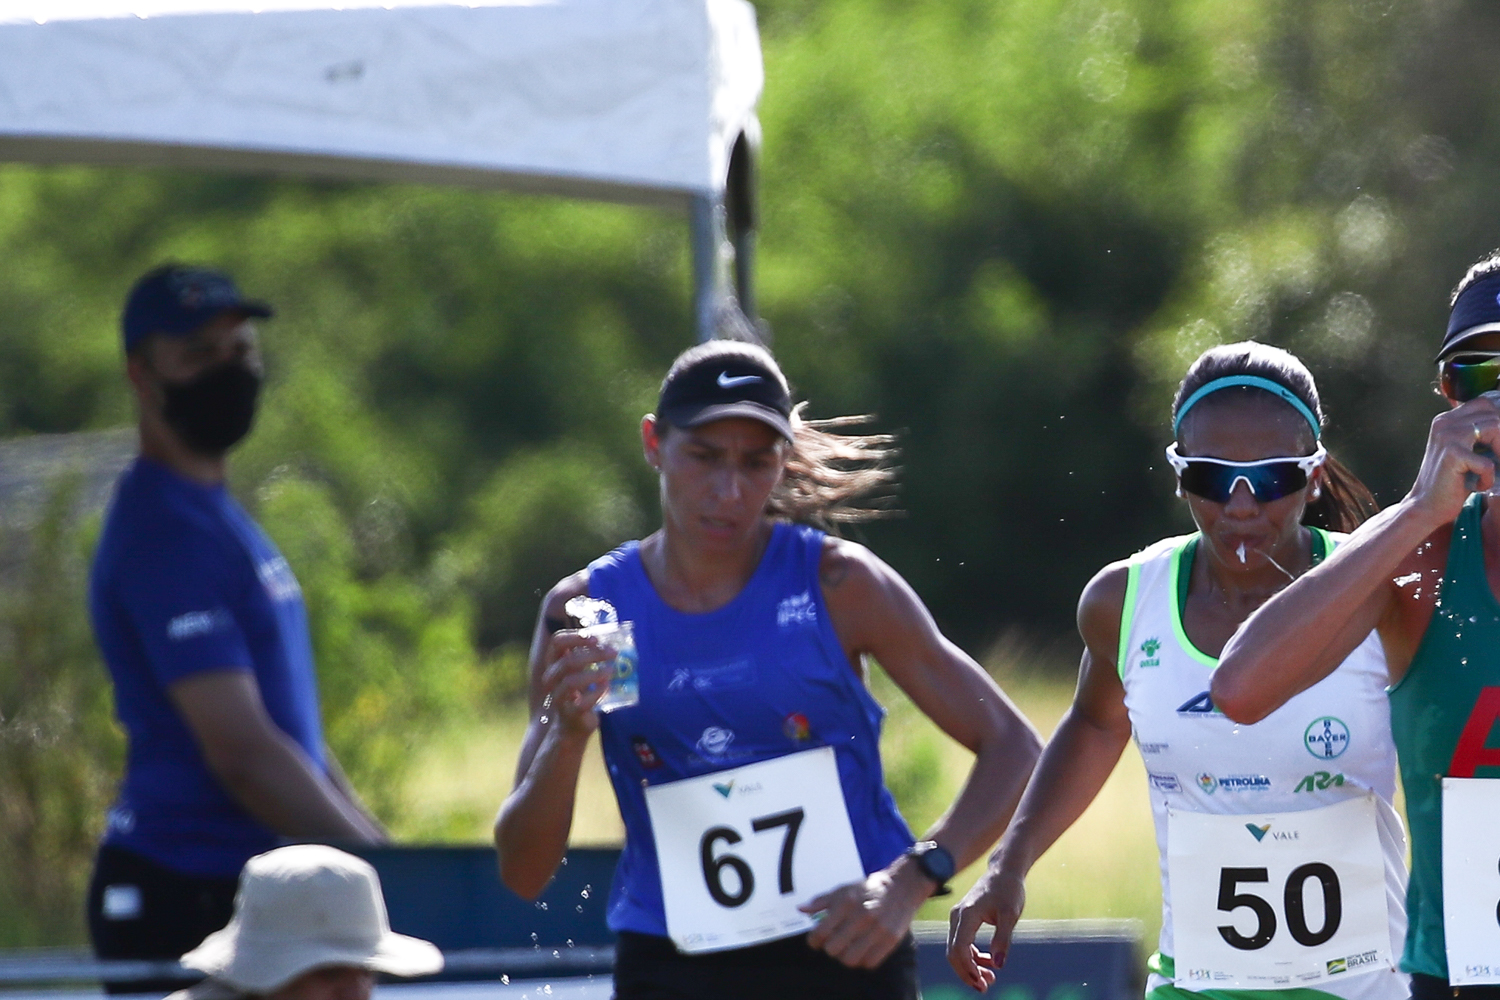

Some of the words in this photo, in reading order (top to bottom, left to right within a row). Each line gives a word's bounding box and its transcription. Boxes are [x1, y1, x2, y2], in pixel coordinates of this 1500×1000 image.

[1309, 735, 1346, 743] BAYER
[1323, 719, 1334, 757] BAYER
[1219, 777, 1271, 787] PETROLINA
[1272, 830, 1300, 841] VALE
[700, 806, 805, 908] 67
[1217, 862, 1342, 951] 50
[1347, 954, 1378, 969] BRASIL
